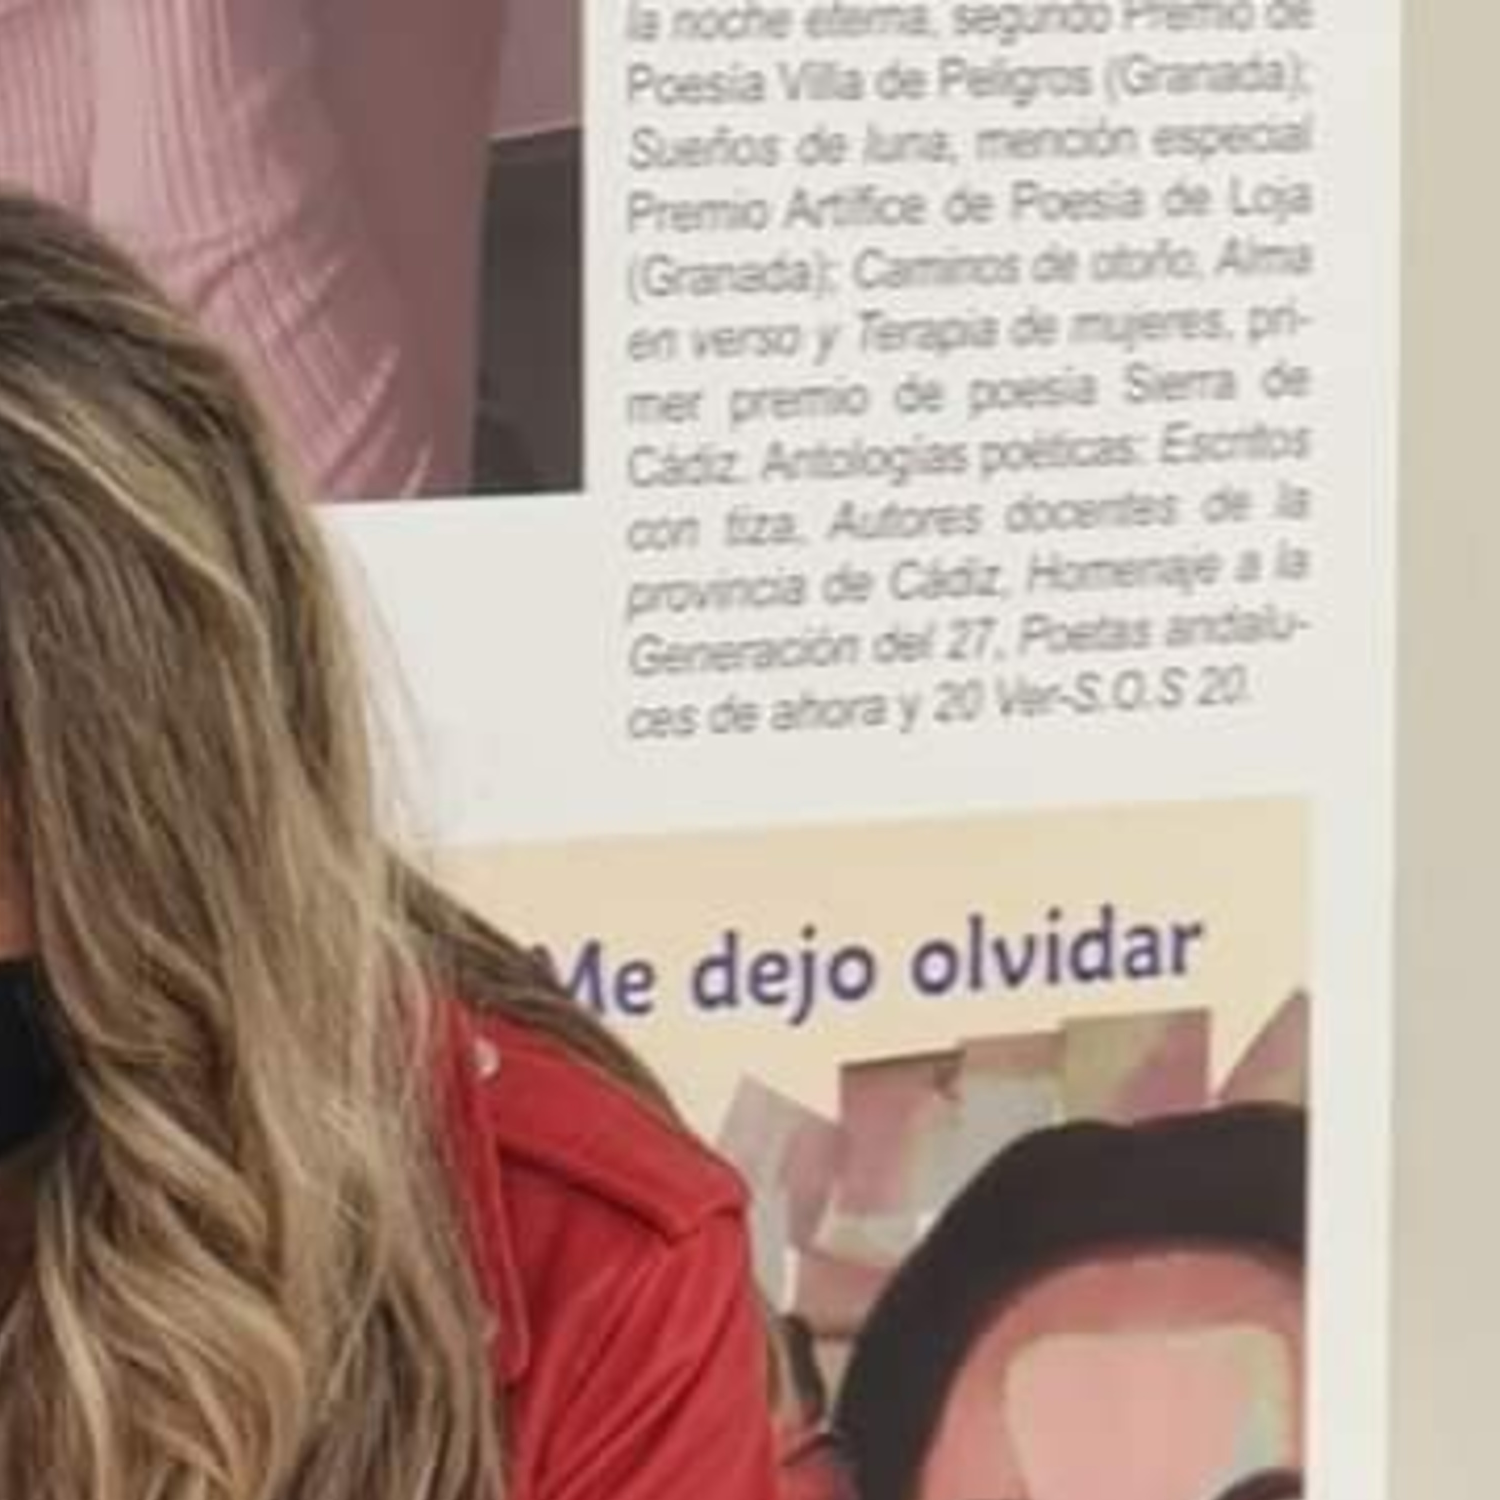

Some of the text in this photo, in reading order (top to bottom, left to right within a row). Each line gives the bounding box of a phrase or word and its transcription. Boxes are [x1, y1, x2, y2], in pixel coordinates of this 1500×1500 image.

[876, 60, 927, 101] de
[796, 125, 848, 166] de
[944, 186, 996, 225] de
[1164, 180, 1210, 218] de
[1032, 243, 1078, 284] de
[814, 326, 838, 367] y
[1009, 308, 1058, 347] de
[894, 371, 944, 414] de
[1261, 357, 1311, 399] de
[1202, 486, 1254, 522] de
[822, 565, 873, 605] de
[708, 693, 759, 734] de
[898, 694, 919, 733] y
[532, 903, 1206, 1026] Me dejo olvidar
